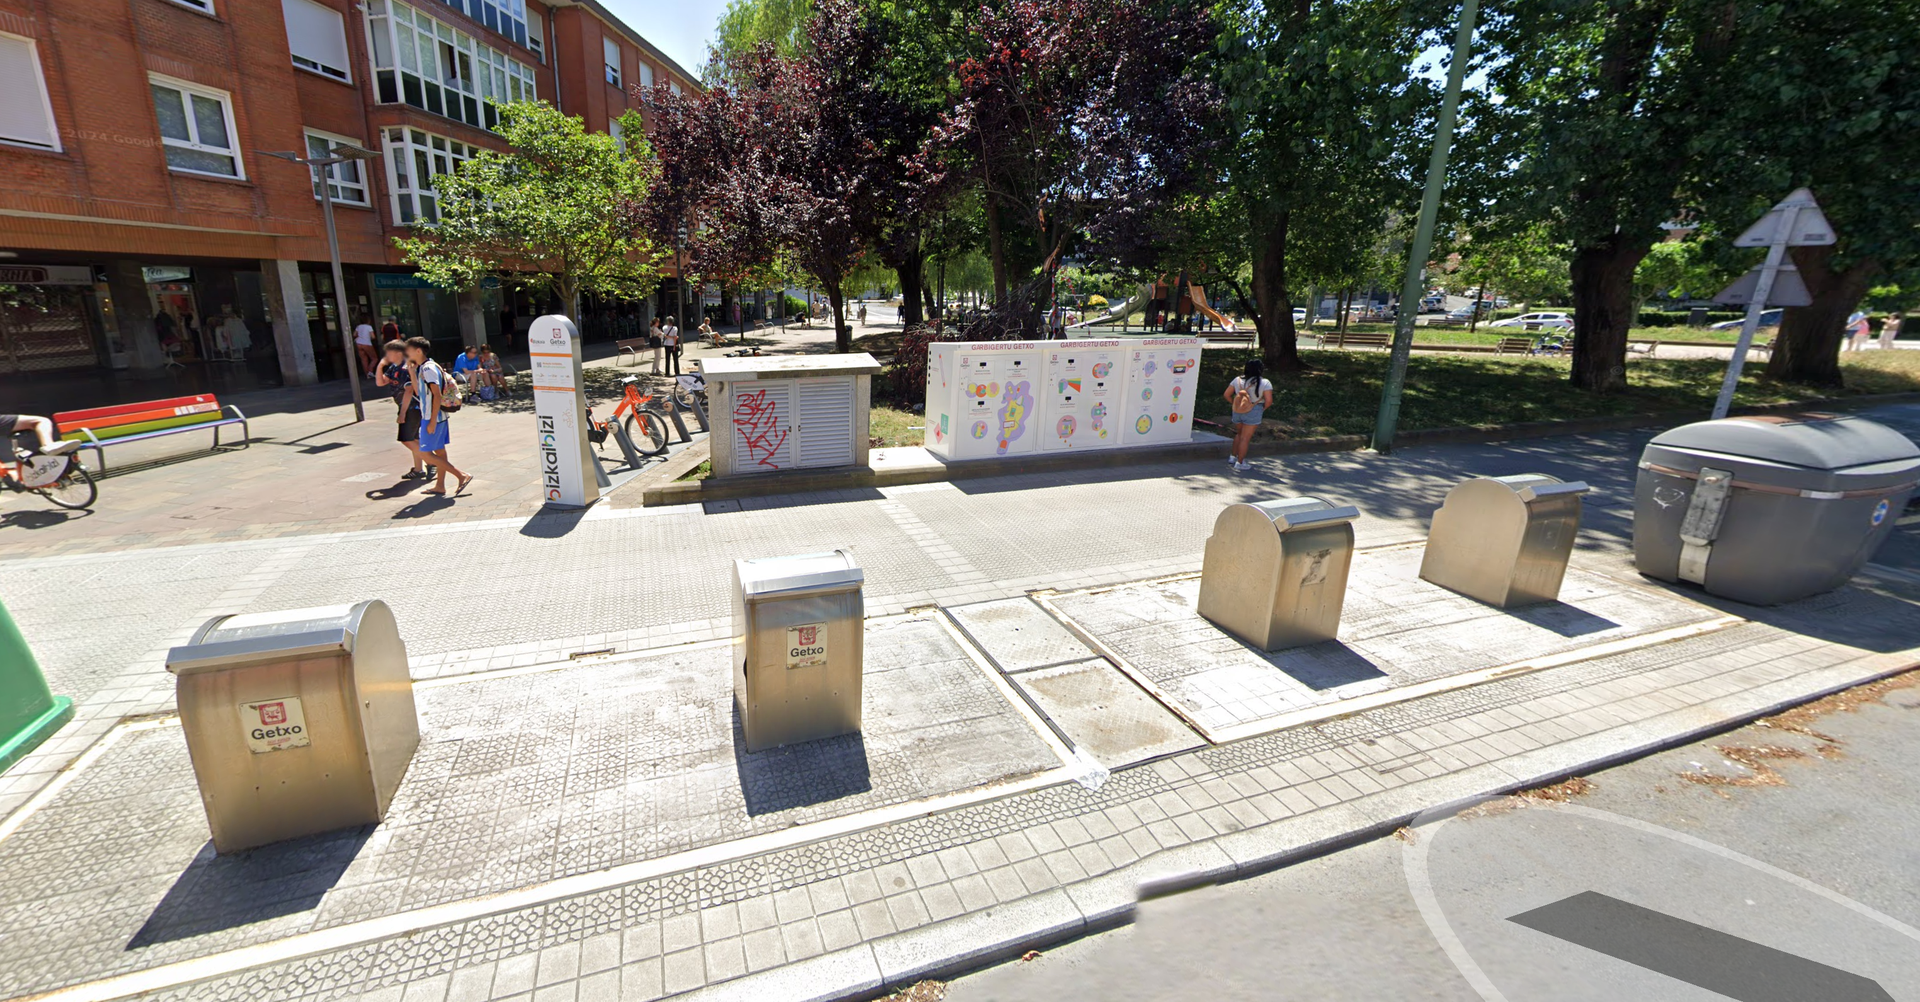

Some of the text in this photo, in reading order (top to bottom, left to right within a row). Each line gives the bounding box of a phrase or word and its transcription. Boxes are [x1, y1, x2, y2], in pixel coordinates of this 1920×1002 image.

[971, 343, 1012, 351] GARBIGERTU
[1060, 340, 1120, 349] GARBIGERTU GETXO
[539, 415, 562, 501] bizkaibizi
[790, 646, 824, 658] Getxo
[251, 725, 302, 740] Getxo
